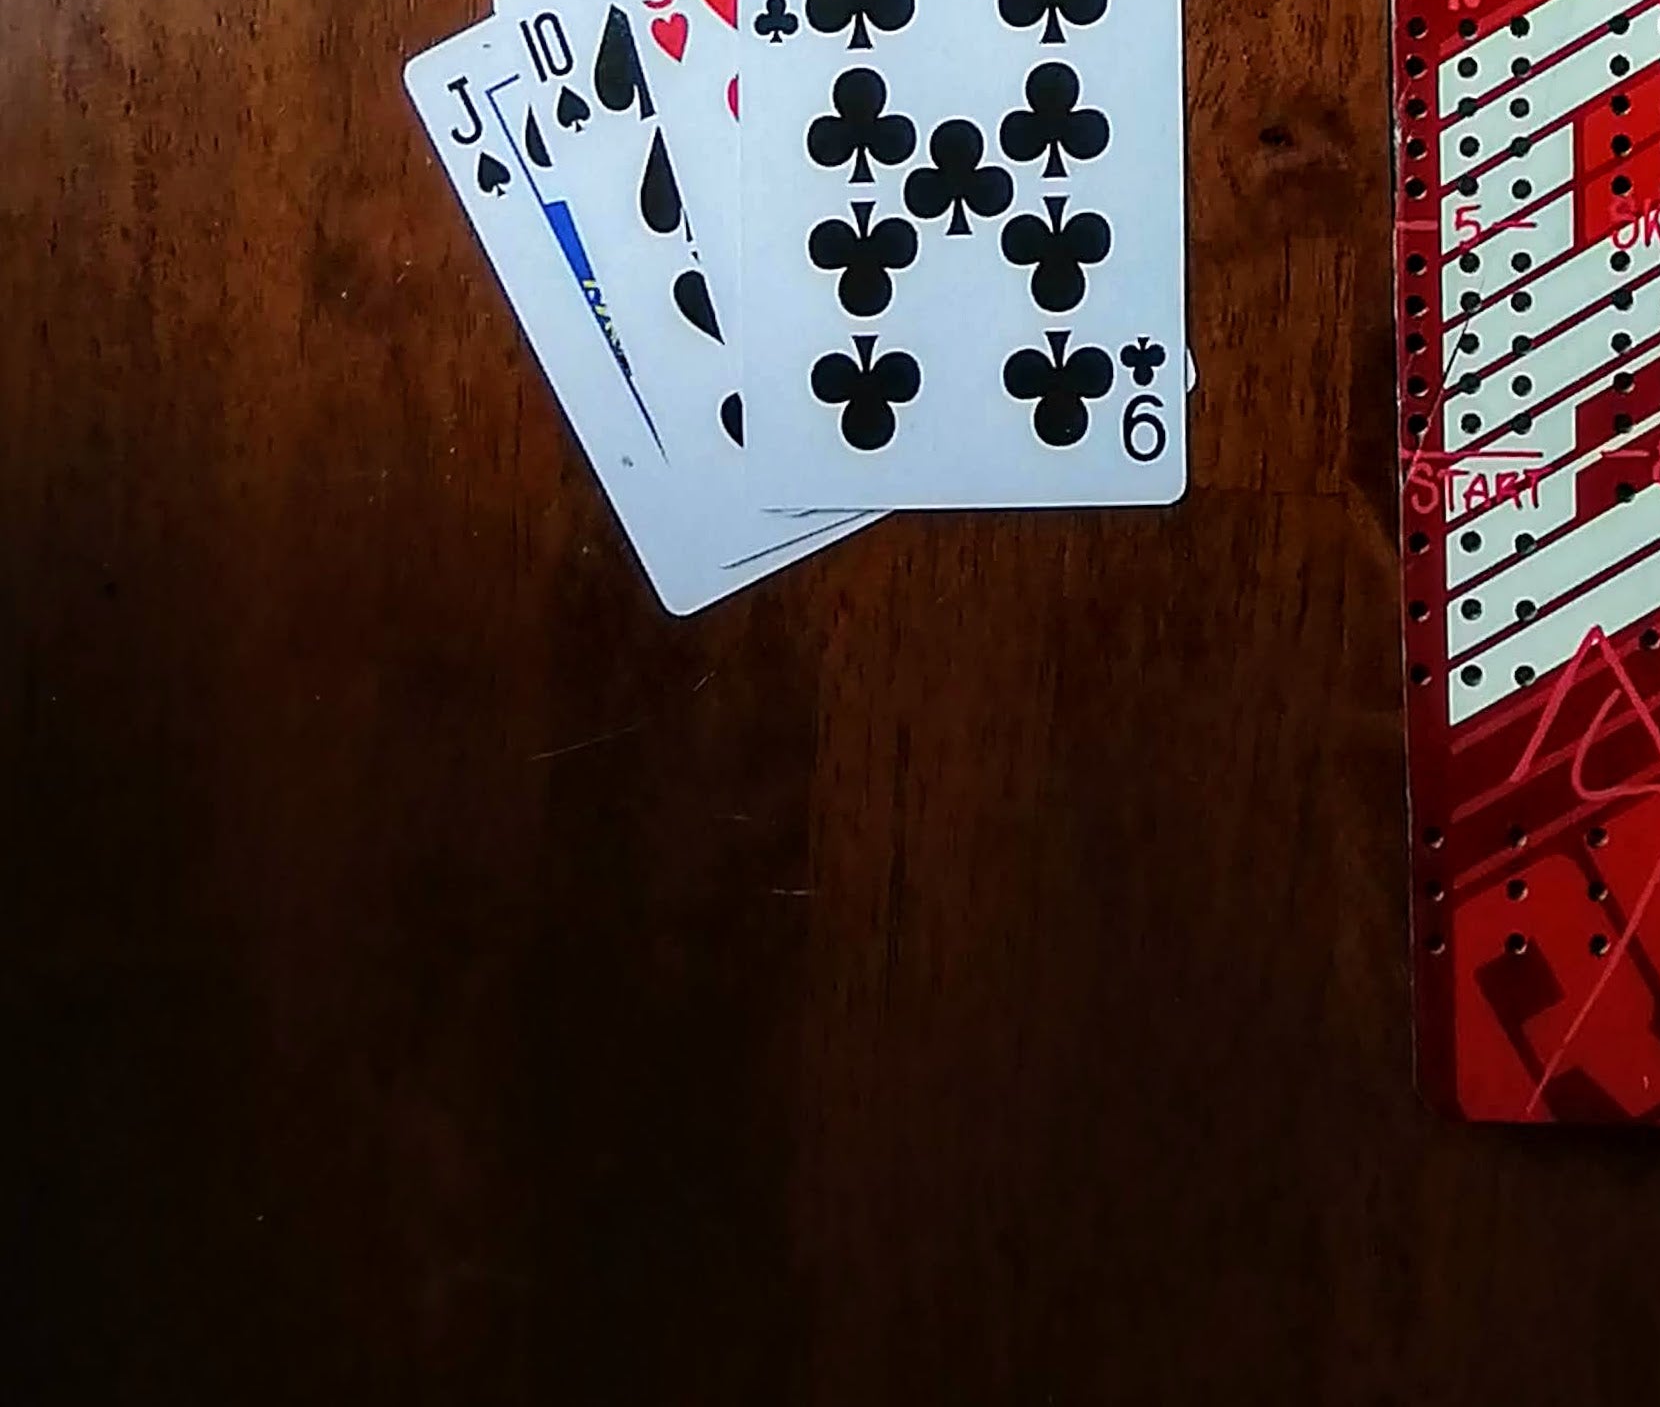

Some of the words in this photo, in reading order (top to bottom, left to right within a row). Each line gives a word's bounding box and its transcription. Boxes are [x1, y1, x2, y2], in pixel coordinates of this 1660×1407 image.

[519, 12, 576, 83] 10
[446, 75, 483, 146] J
[1454, 205, 1482, 249] 5
[1411, 461, 1552, 514] START
